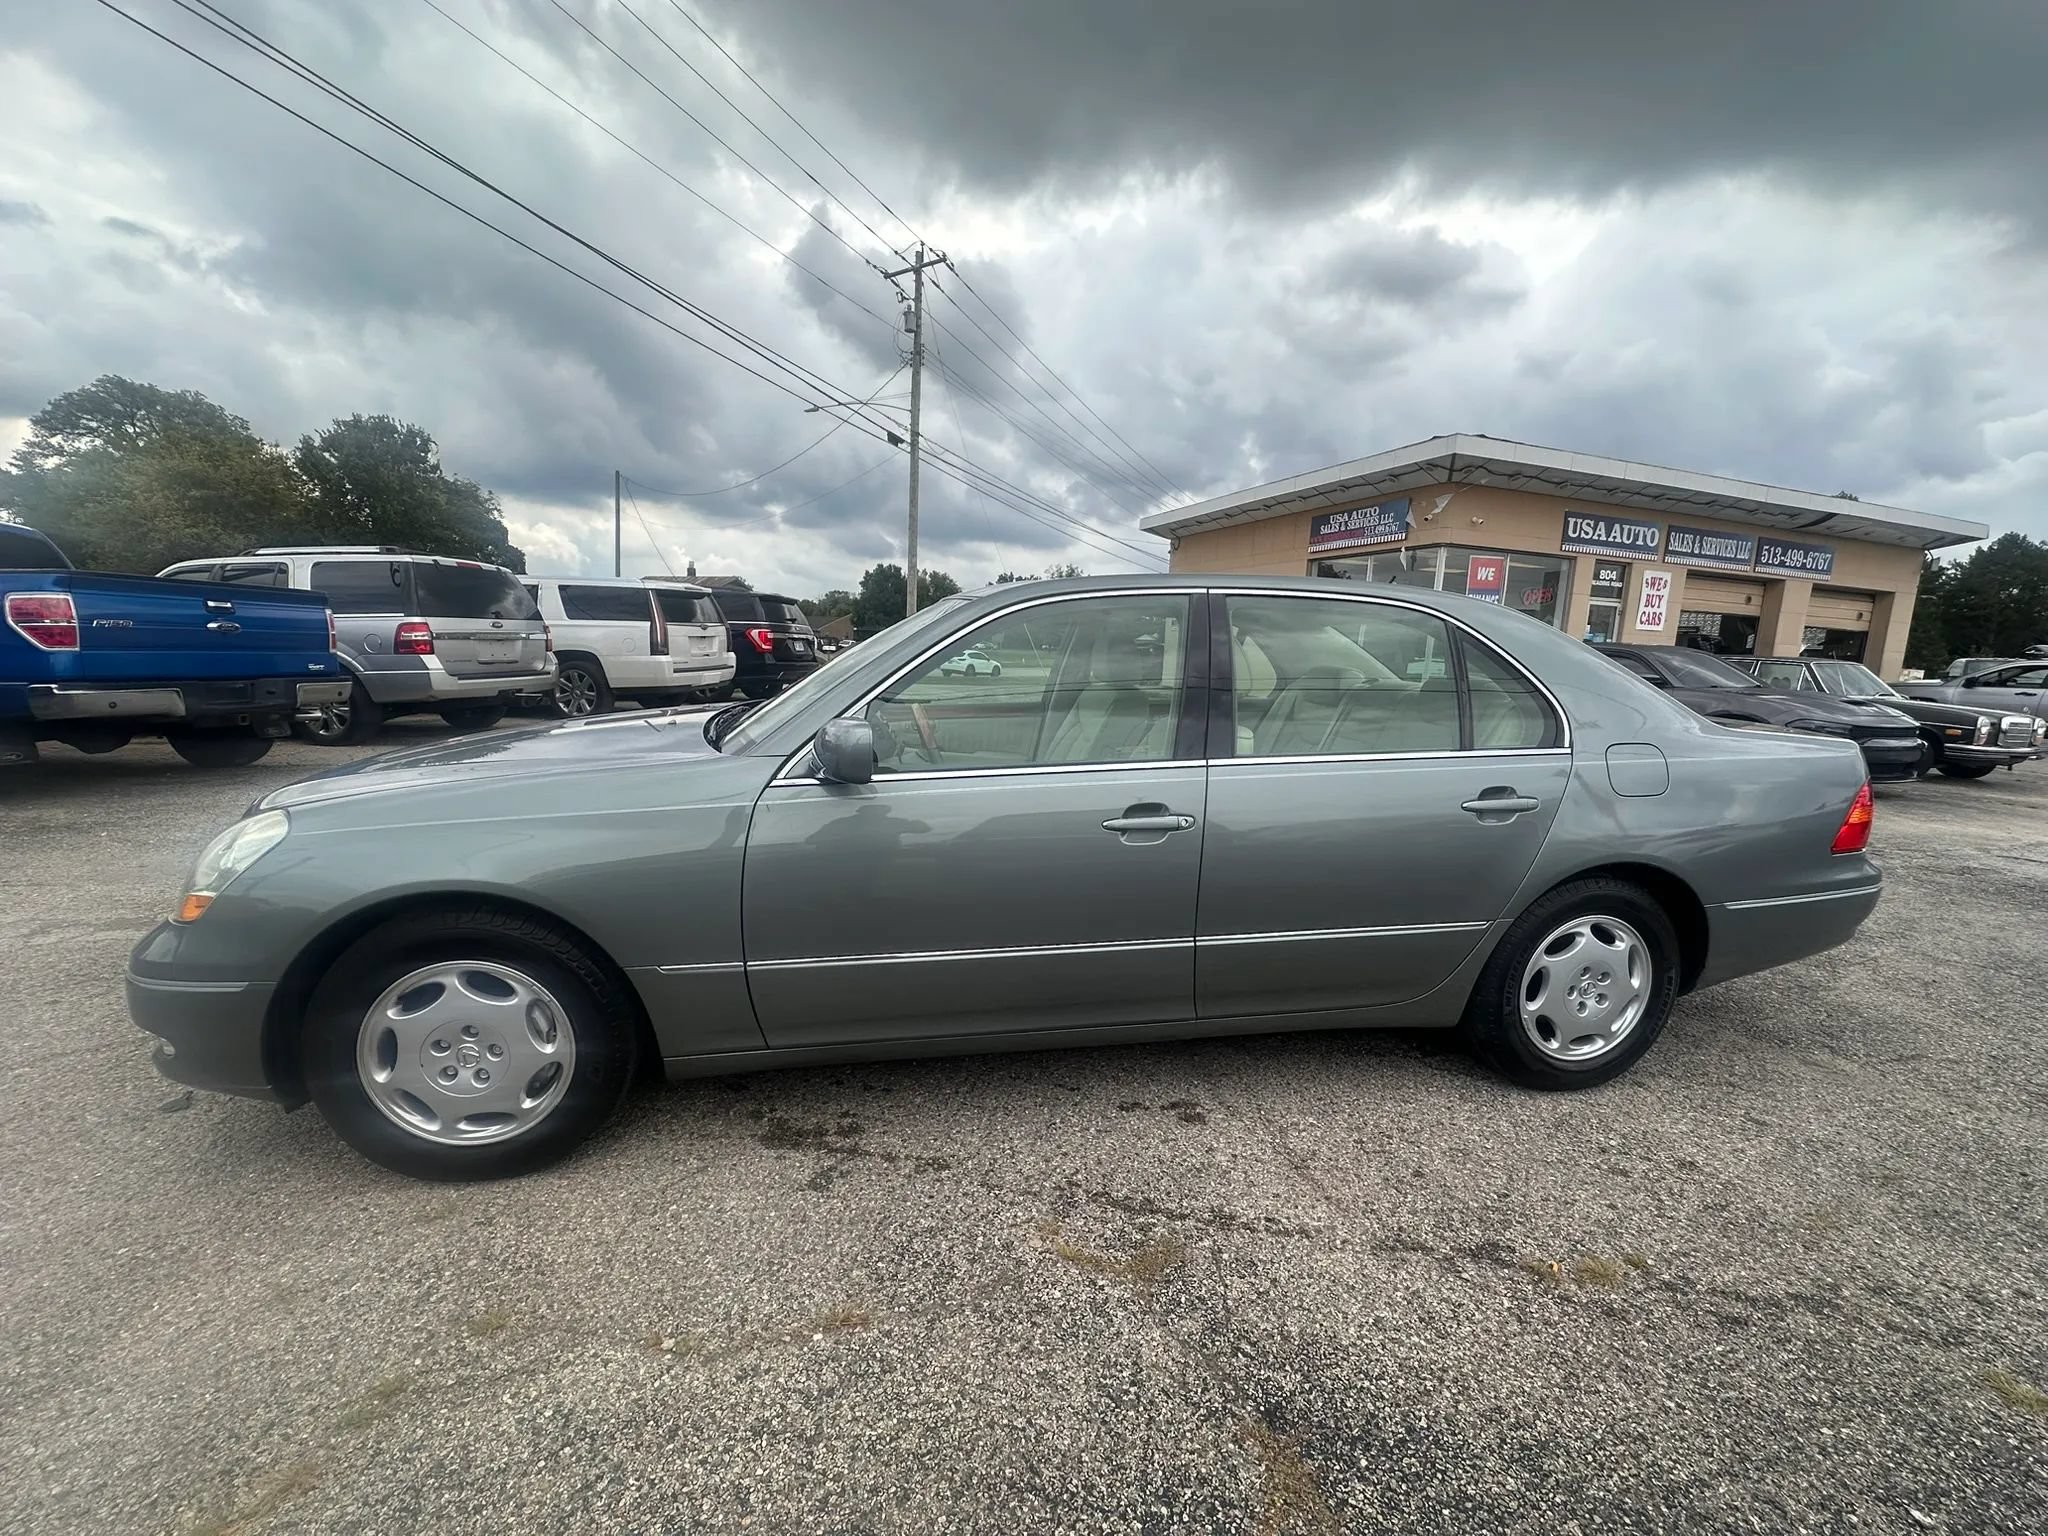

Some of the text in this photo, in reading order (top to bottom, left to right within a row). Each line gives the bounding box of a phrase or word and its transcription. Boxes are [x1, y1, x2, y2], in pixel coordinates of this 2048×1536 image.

[1320, 513, 1394, 534] SALES & SERVICES LLC
[1330, 506, 1379, 524] USA AUTO
[1567, 517, 1660, 547] USA AUTO
[1668, 532, 1752, 560] SALES & SERVICES LLC
[1761, 545, 1831, 571] 513-499-6767
[1477, 567, 1496, 581] WE
[1599, 570, 1617, 581] 804
[1523, 587, 1553, 605] OPEN
[1644, 594, 1664, 609] BUY
[1640, 611, 1662, 626] CARS
